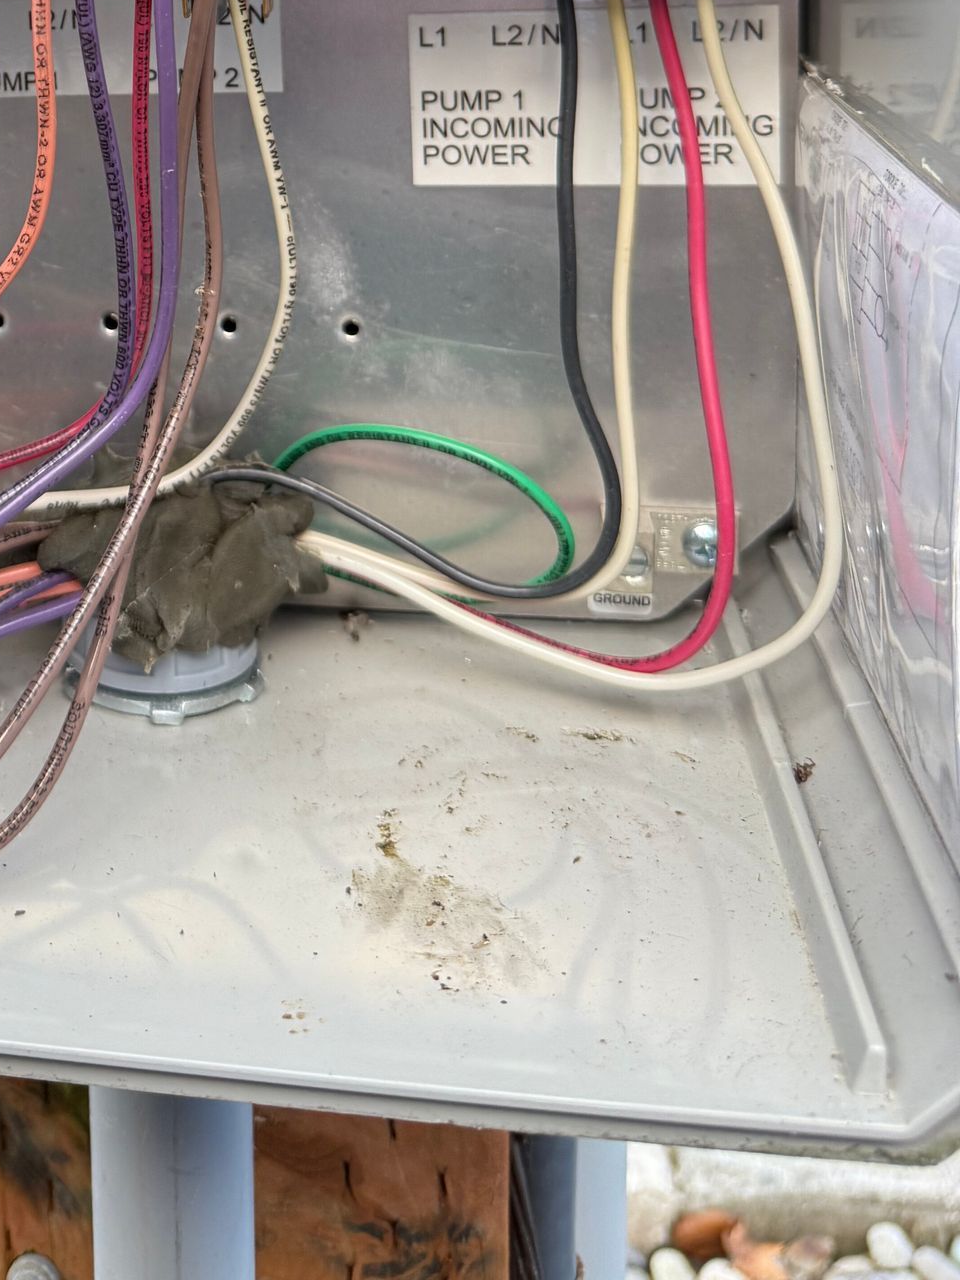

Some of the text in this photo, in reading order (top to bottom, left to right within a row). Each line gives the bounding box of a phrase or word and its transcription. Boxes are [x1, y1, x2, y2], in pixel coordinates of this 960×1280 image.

[418, 26, 447, 48] L1
[224, 67, 239, 88] 2
[420, 89, 524, 112] PUMP 1
[422, 144, 531, 166] POWER
[640, 142, 735, 165] OWER
[593, 592, 651, 607] GROUND
